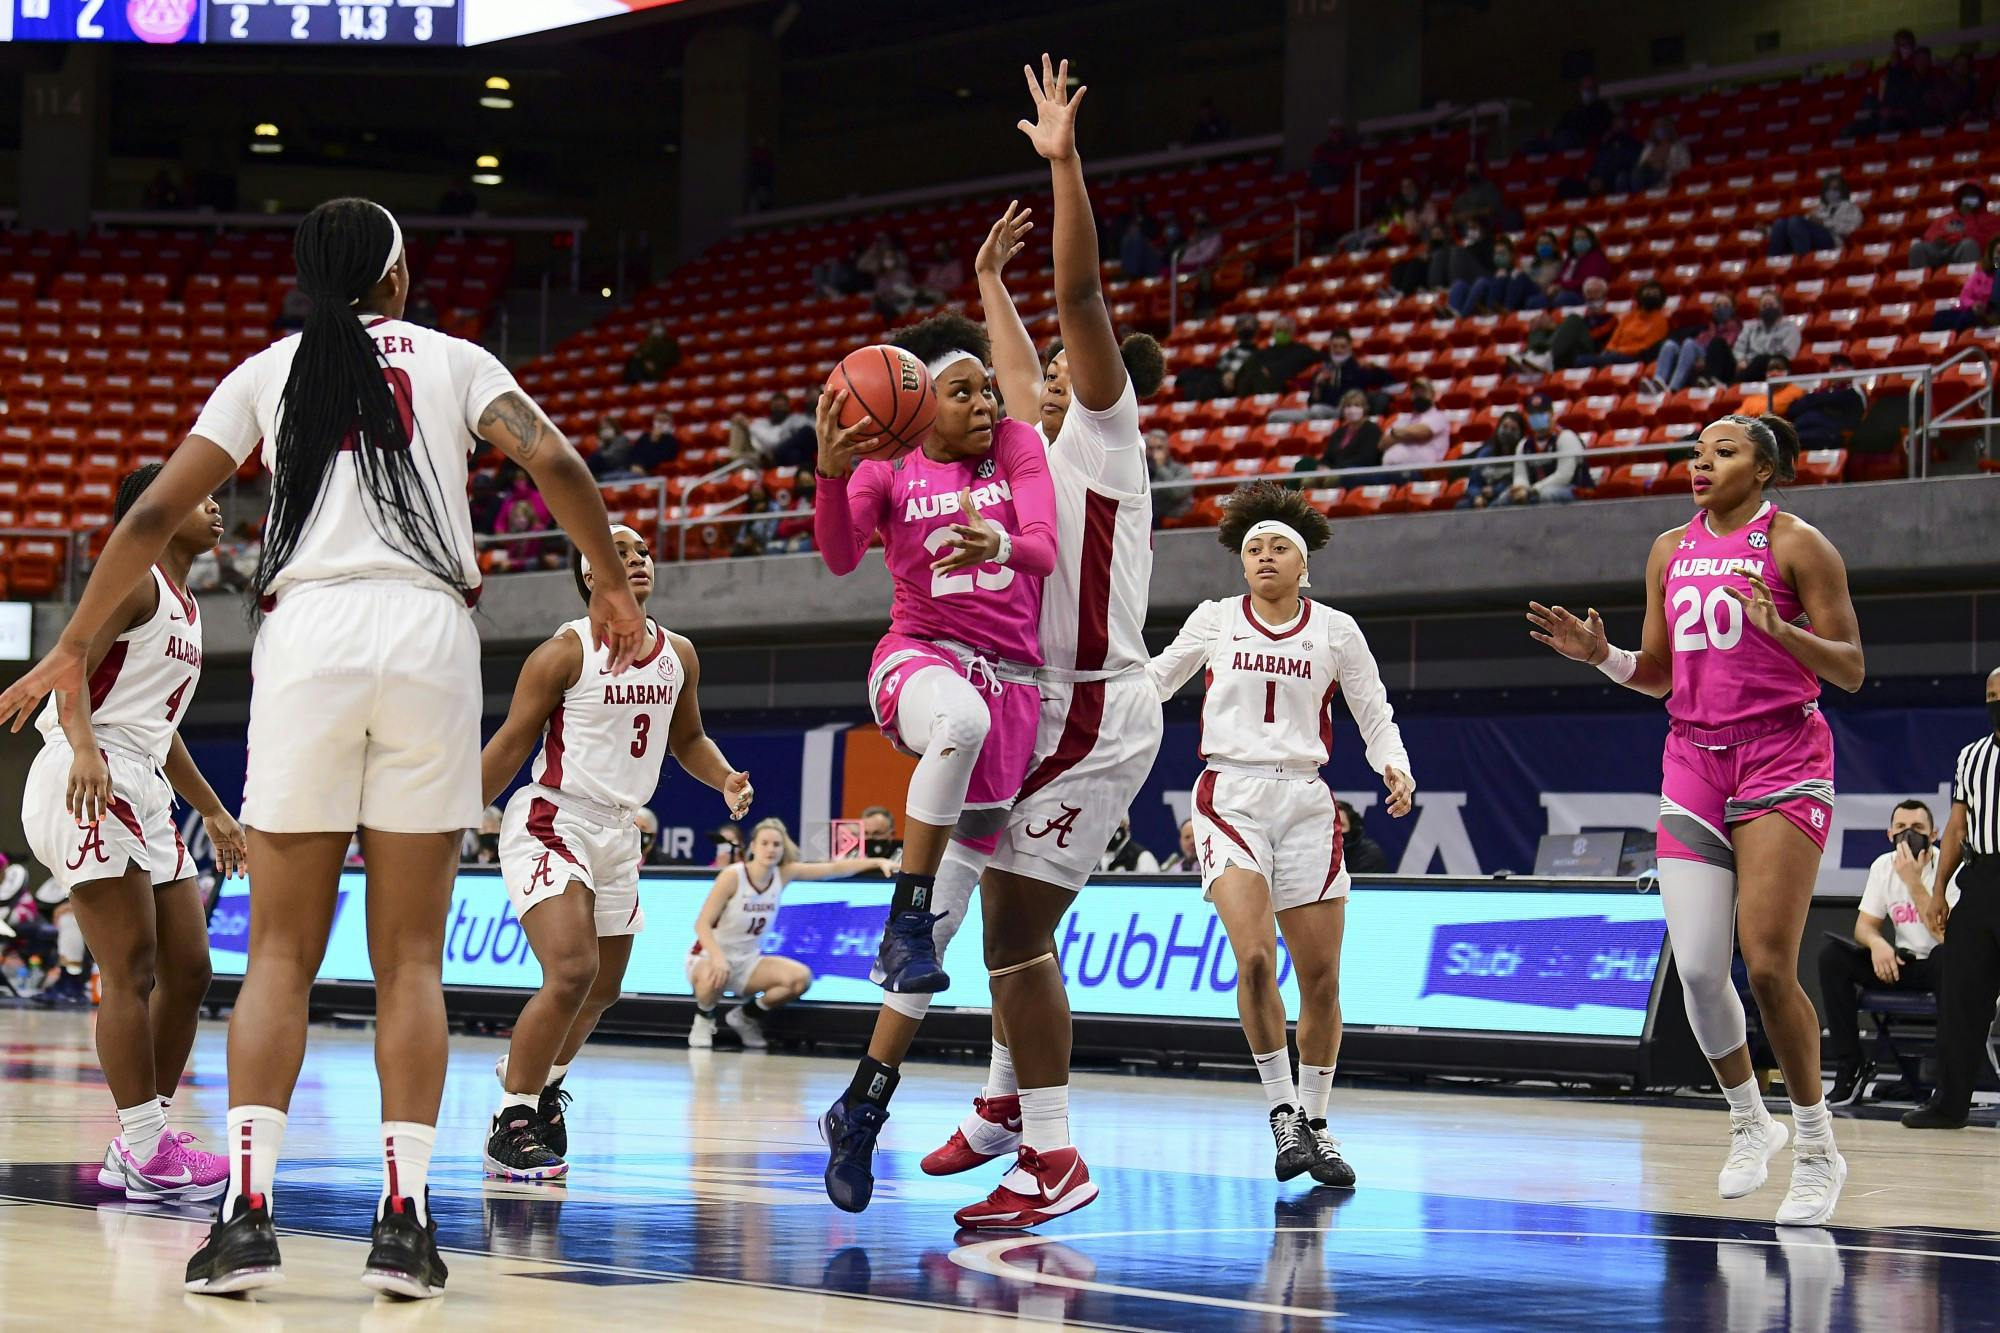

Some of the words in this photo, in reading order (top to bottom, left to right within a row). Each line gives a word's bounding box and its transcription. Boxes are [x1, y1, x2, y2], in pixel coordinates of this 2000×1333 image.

[229, 4, 250, 39] 2
[290, 5, 311, 40] 2
[338, 5, 388, 41] 14.3
[413, 6, 434, 41] 3
[904, 479, 1014, 523] AUBRN
[1748, 530, 1769, 549] SEC
[1671, 585, 1744, 653] 20
[1231, 651, 1313, 681] ALABAMA
[165, 675, 193, 723] 4
[1263, 680, 1277, 724] 1
[630, 712, 651, 759] 3
[1025, 801, 1082, 849] A
[746, 917, 767, 936] 12
